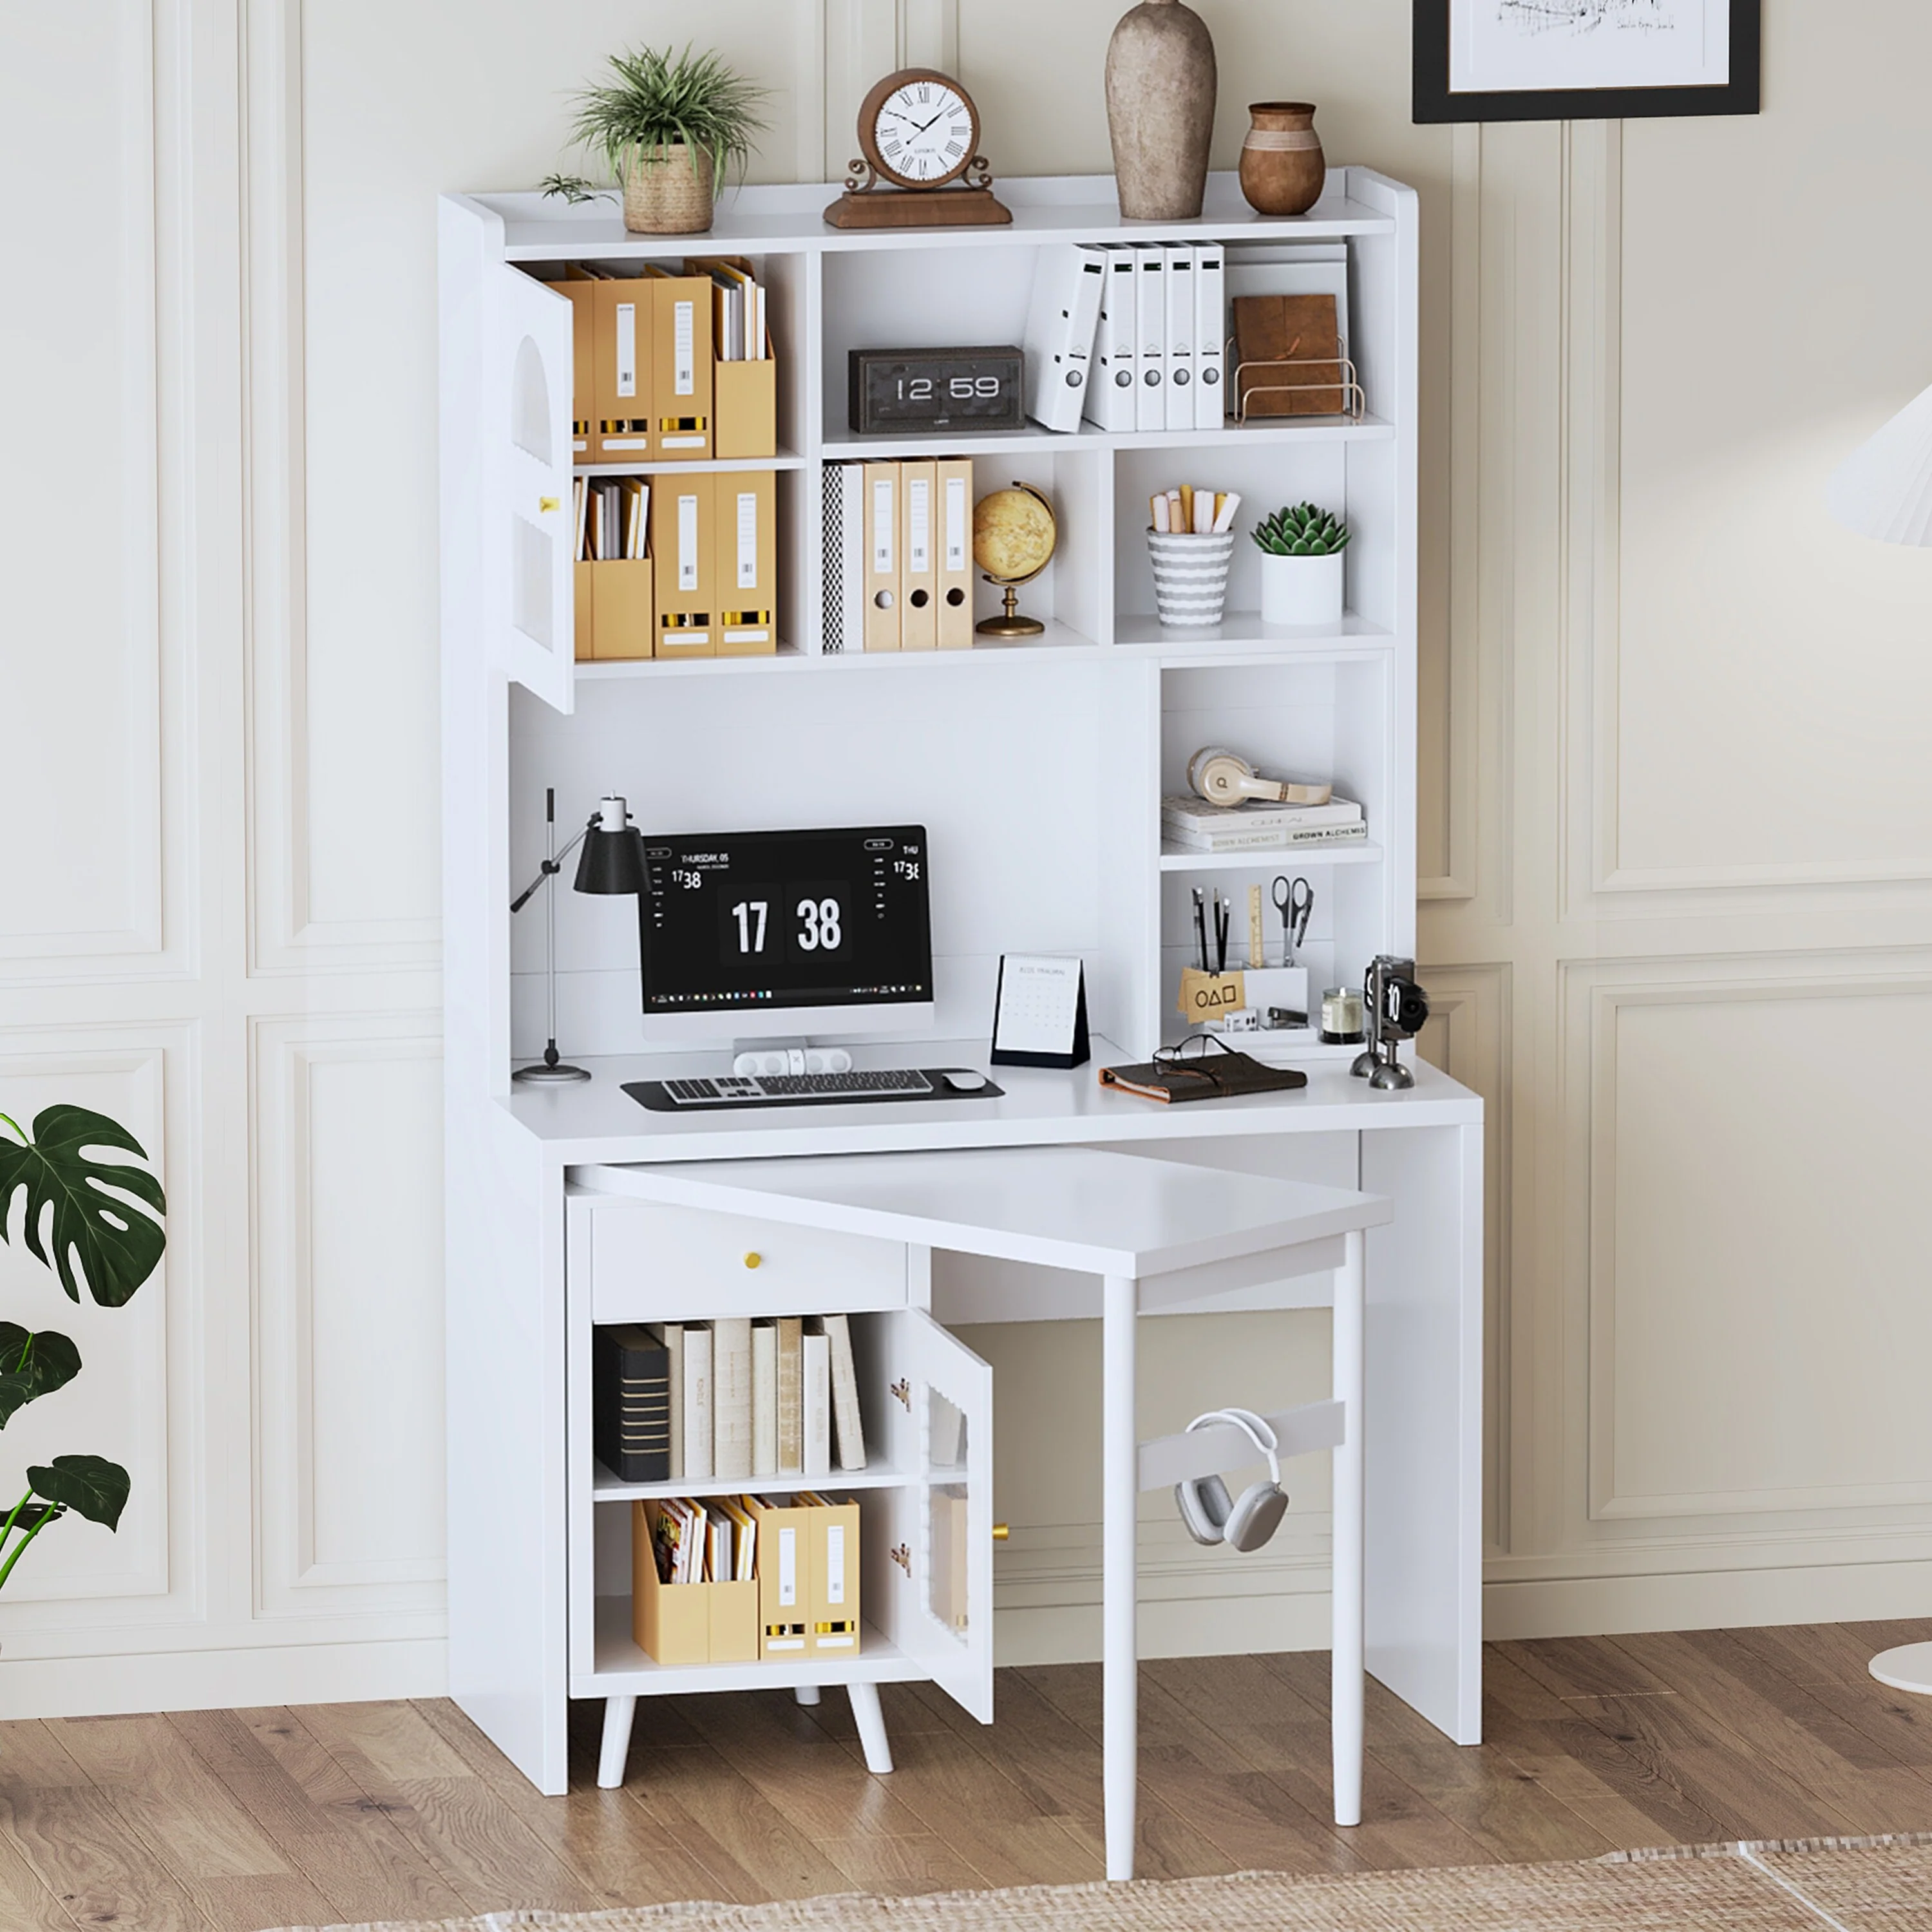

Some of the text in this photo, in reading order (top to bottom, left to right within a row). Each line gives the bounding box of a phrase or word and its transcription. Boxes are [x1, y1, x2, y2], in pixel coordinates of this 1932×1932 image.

[898, 376, 999, 400] 12 59
[683, 871, 701, 889] 38
[732, 898, 841, 952] 17 38
